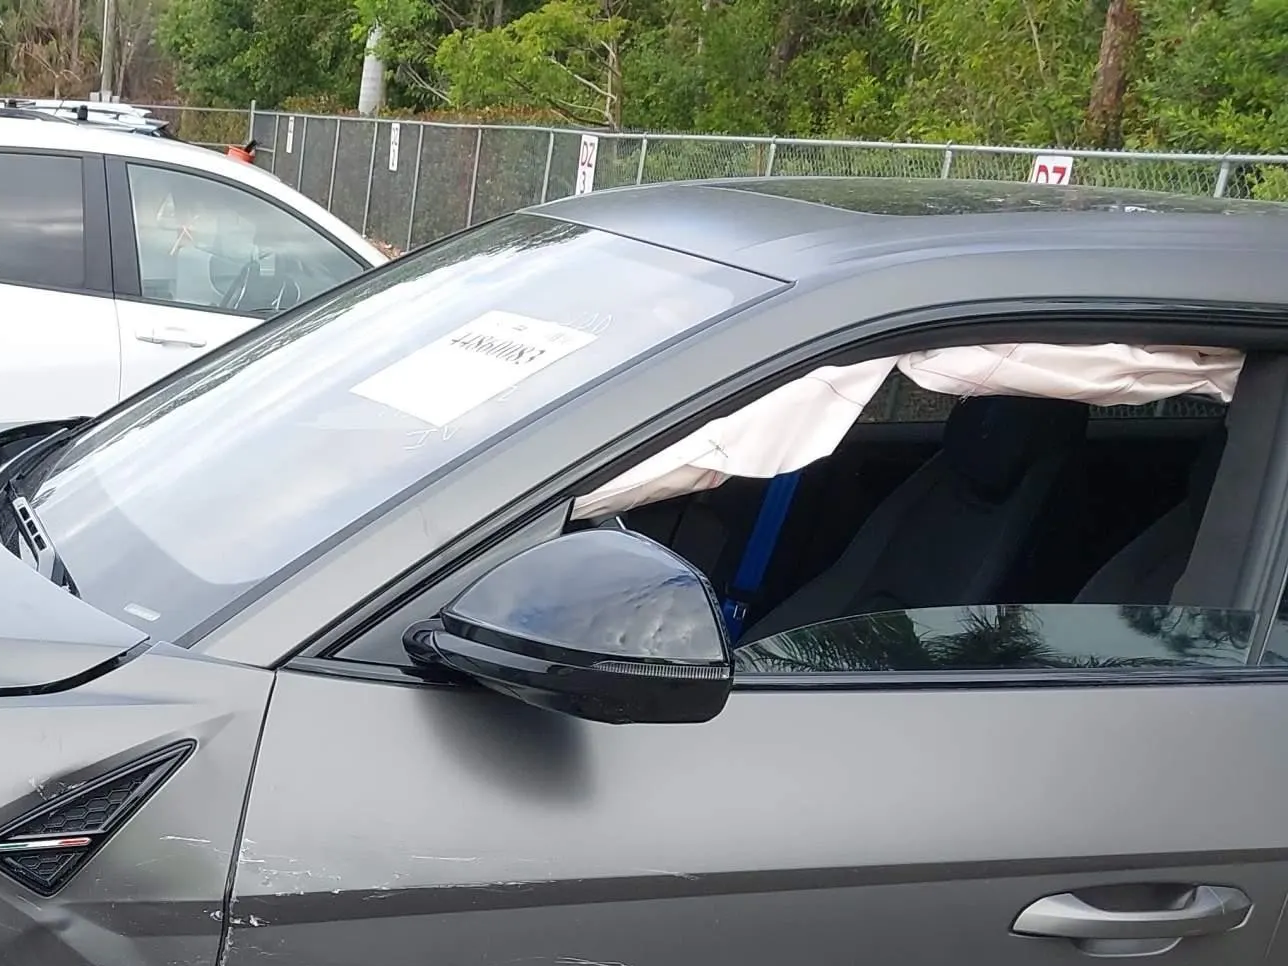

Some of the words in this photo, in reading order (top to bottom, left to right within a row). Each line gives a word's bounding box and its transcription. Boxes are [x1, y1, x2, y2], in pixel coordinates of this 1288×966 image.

[581, 141, 596, 168] DZ
[580, 171, 587, 194] 3
[450, 332, 546, 365] 44860083
